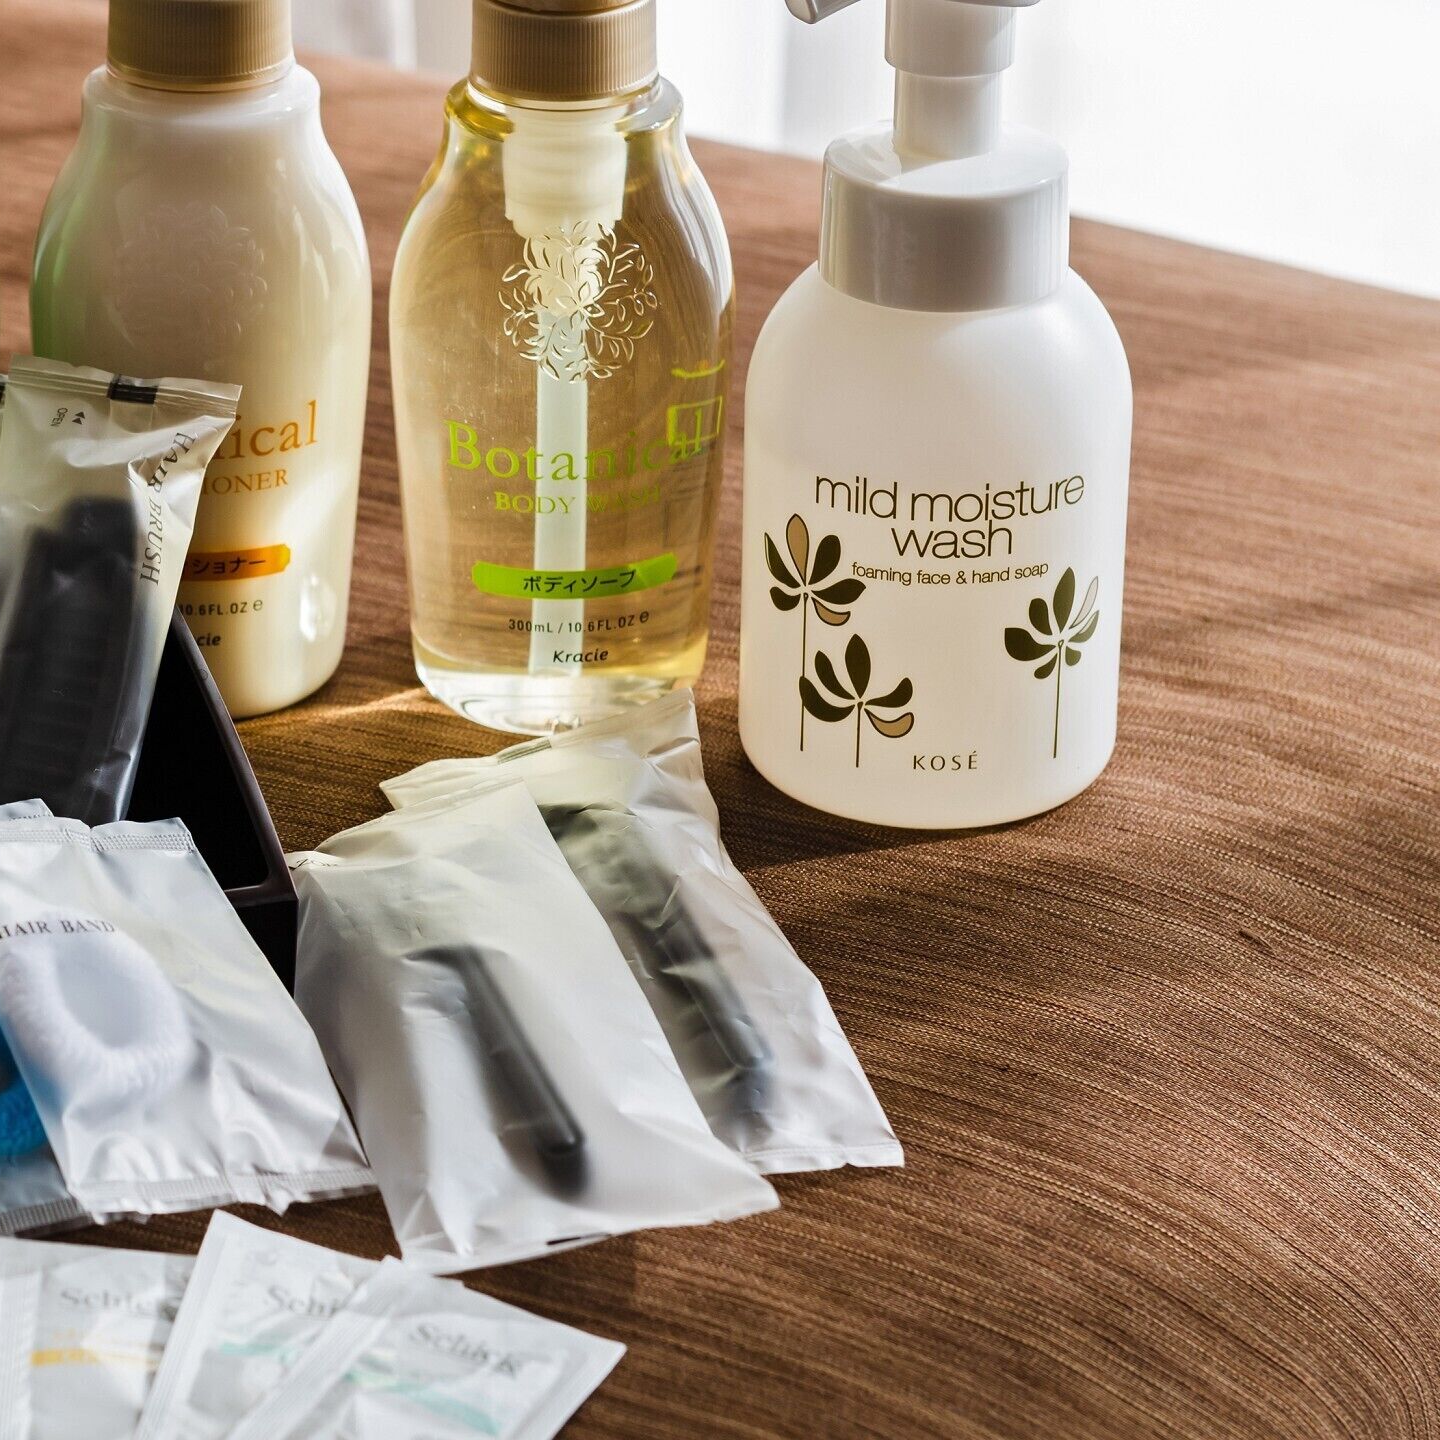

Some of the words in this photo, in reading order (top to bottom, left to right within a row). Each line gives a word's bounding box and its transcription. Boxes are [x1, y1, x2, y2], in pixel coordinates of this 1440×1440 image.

[214, 399, 318, 460] ical
[444, 407, 704, 481] Botanical
[147, 432, 196, 495] HAIR
[495, 491, 575, 514] BODY
[816, 475, 898, 520] mild
[910, 474, 1085, 523] moisture
[139, 496, 164, 586] BRUSH
[891, 520, 1013, 559] wash
[522, 569, 637, 594] ボディソープ
[852, 561, 912, 586] foaming
[916, 566, 951, 585] face
[955, 570, 967, 585] &
[971, 567, 1010, 584] hand
[1014, 562, 1049, 582] soap
[508, 618, 554, 633] 300mL
[567, 613, 635, 633] 10.6FL.OZ
[552, 648, 609, 664] Kracie
[912, 751, 979, 772] KOSÉ
[58, 920, 116, 934] BAND
